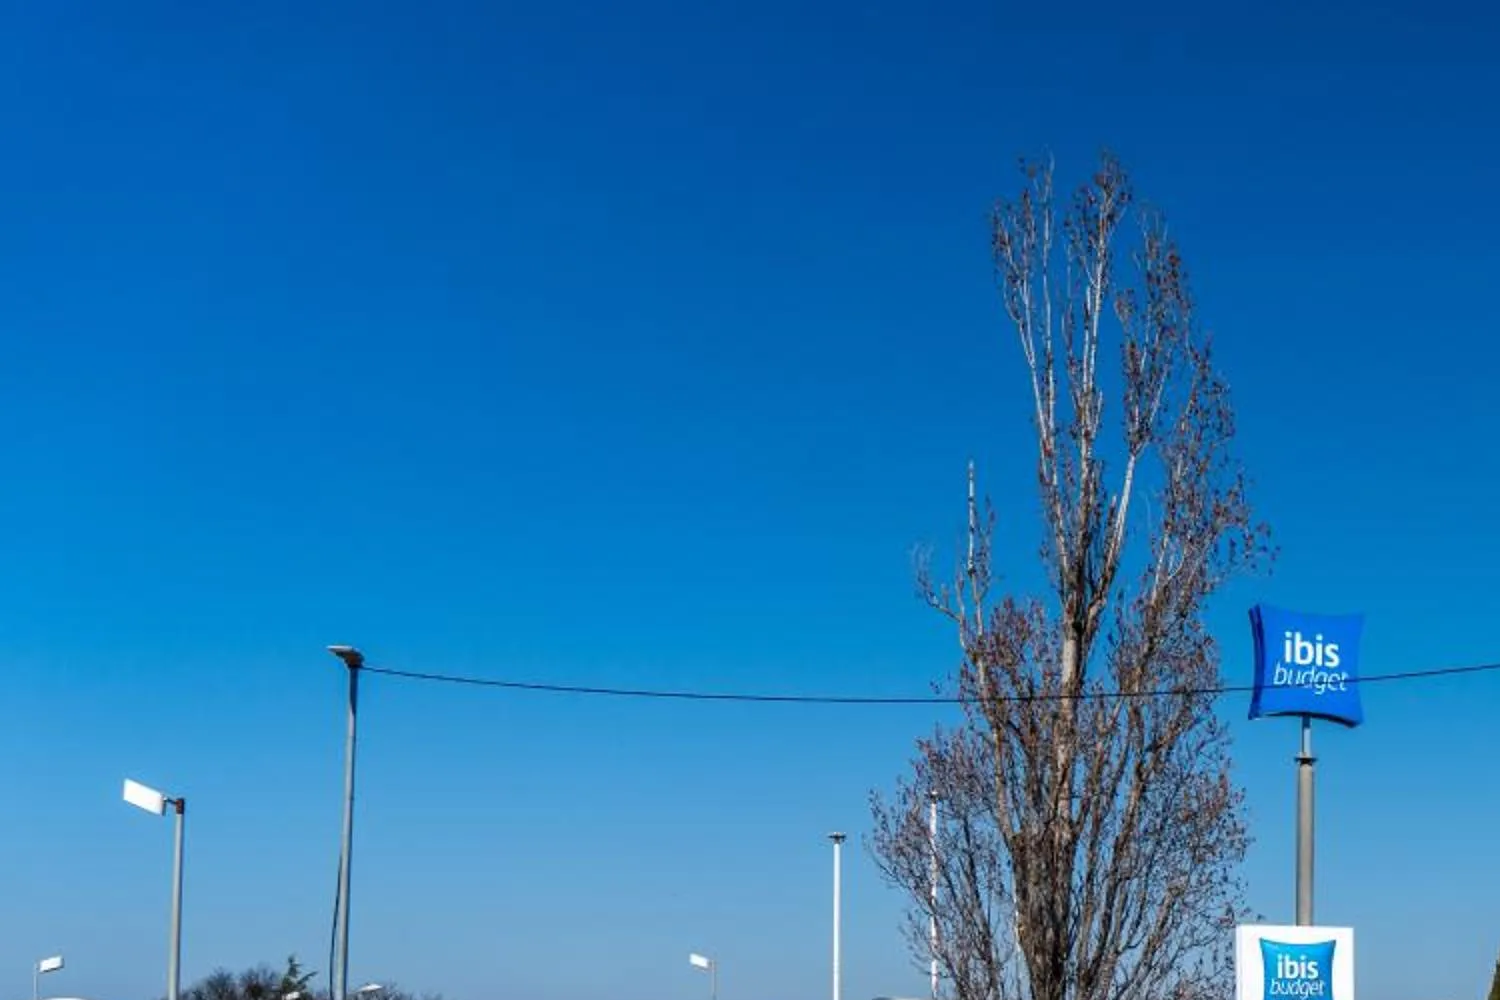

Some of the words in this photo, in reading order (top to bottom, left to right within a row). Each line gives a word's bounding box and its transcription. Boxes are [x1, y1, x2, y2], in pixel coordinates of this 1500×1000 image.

[1284, 630, 1340, 668] ibis
[1273, 661, 1350, 696] budget
[1277, 954, 1319, 979] ibis
[1269, 978, 1326, 1000] budget
